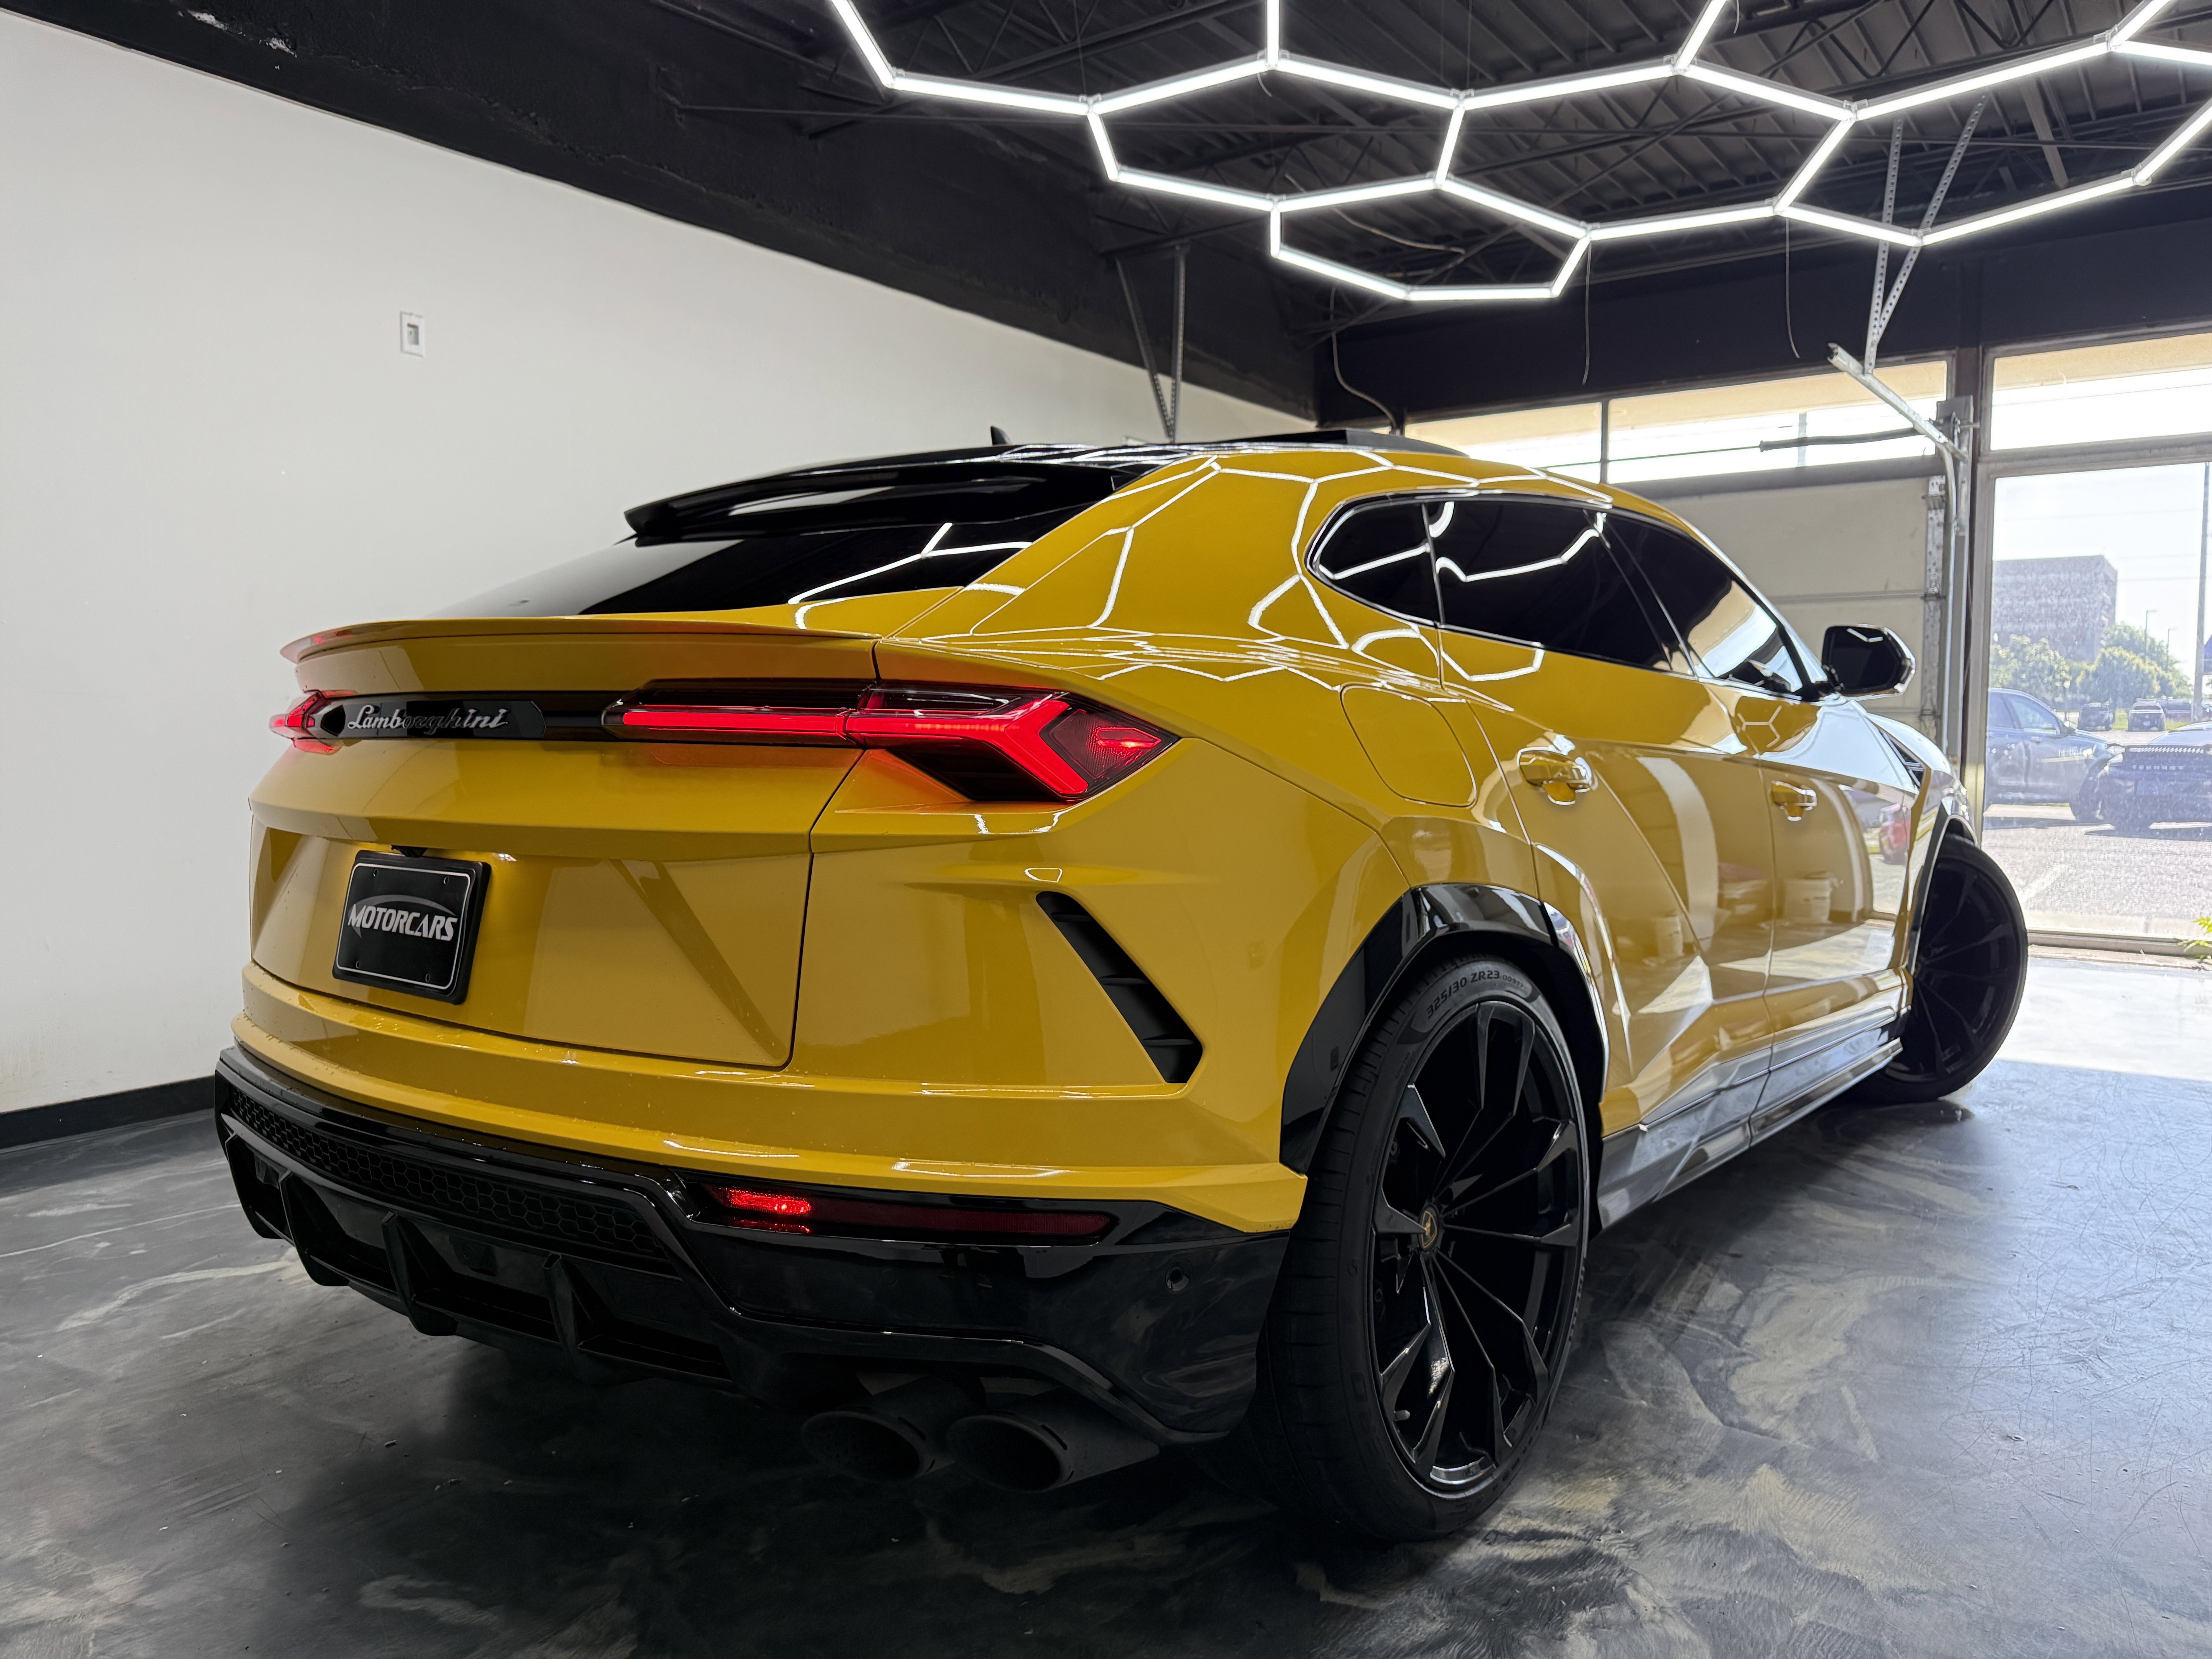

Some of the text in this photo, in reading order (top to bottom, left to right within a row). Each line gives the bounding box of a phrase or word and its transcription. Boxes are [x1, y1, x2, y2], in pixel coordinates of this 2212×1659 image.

[348, 704, 509, 735] Lamborghini
[348, 904, 458, 941] MOTORCARS
[1427, 977, 1467, 1020] 325/30
[1470, 970, 1499, 982] ZR23
